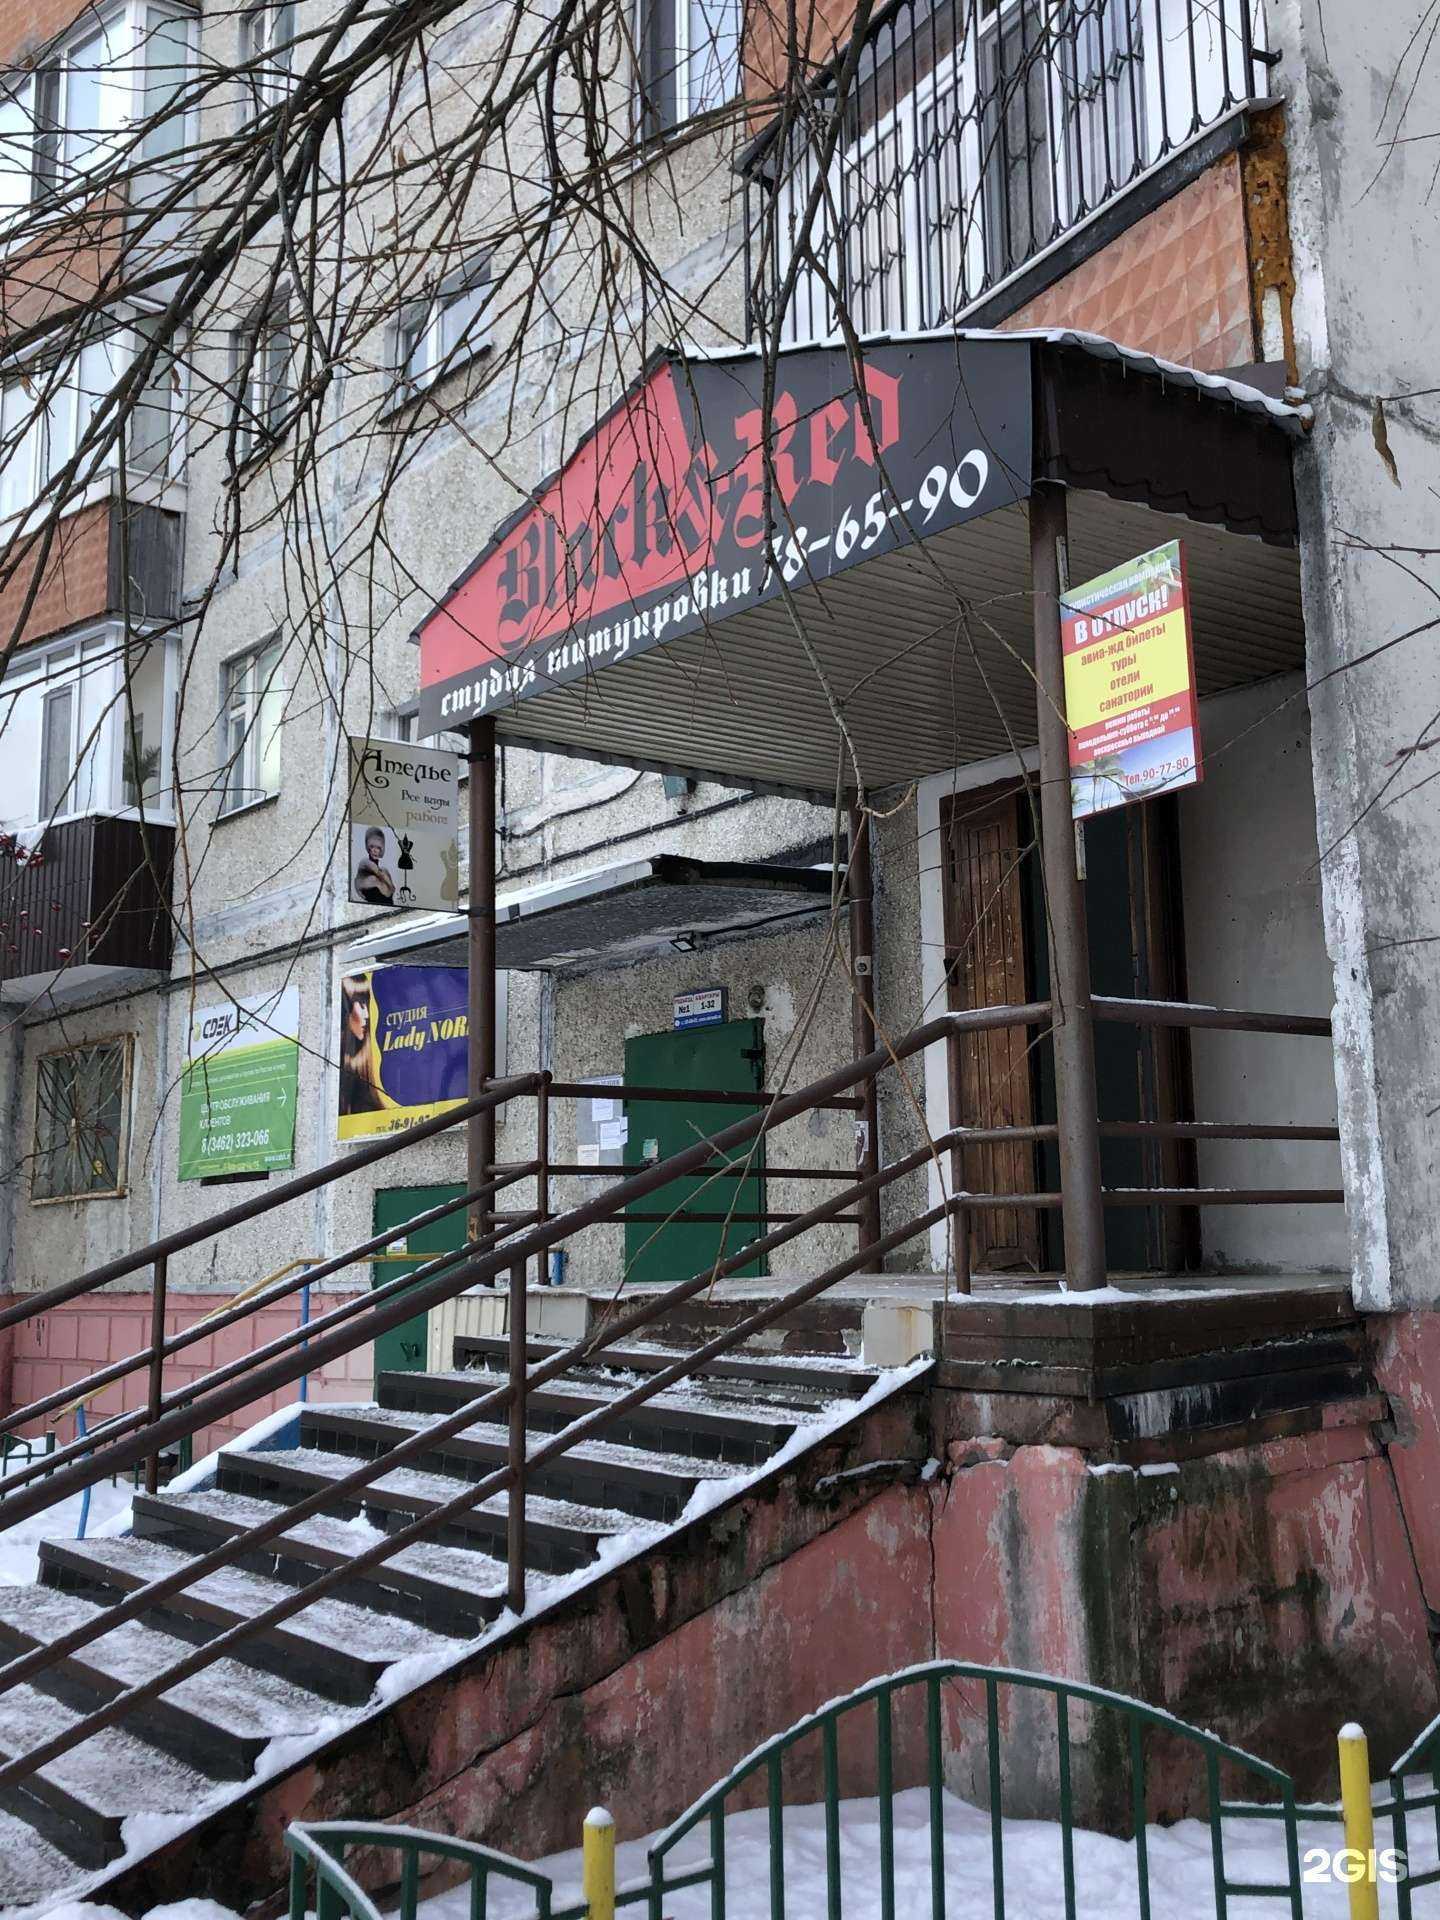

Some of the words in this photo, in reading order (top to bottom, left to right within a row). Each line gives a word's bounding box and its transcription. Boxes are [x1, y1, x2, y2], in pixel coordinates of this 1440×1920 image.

[1074, 620, 1088, 645] В
[1091, 584, 1169, 638] ОТПУСК!
[1081, 639, 1124, 666] авиа-жд
[1125, 622, 1166, 648] билеты
[1110, 653, 1137, 672] туры
[440, 658, 537, 718] студия
[1110, 670, 1141, 691] отели
[1099, 683, 1154, 713] санатории
[362, 748, 452, 788] Ателье
[401, 789, 421, 801] Все
[423, 795, 451, 811] виды
[384, 1005, 428, 1030] студия
[701, 1000, 715, 1010] 1-32
[202, 1013, 233, 1039] CDEK
[383, 1025, 426, 1052] Lady
[426, 1015, 470, 1044] NOR
